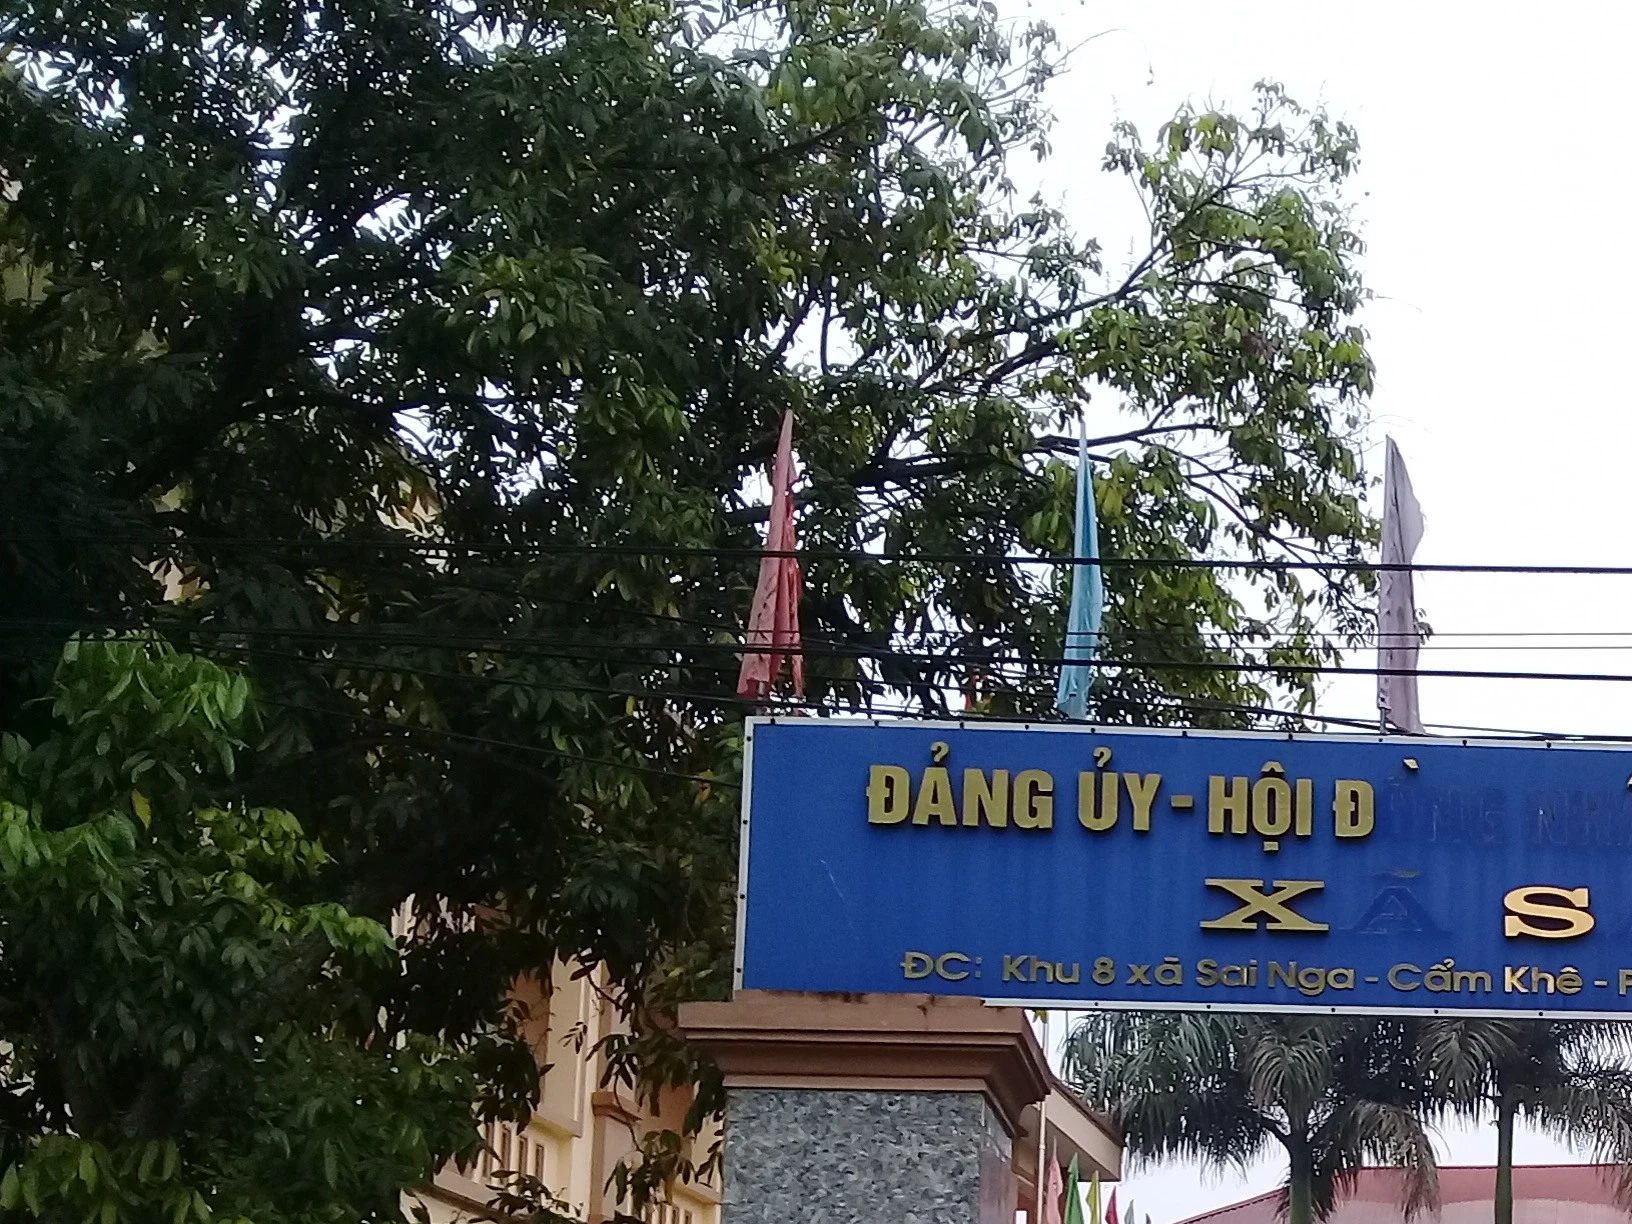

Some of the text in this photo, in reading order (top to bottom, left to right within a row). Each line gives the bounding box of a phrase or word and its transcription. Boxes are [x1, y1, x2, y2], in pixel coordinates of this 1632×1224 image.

[865, 741, 1055, 829] ĐẢNG
[900, 951, 982, 981] ĐC:
[1002, 954, 1080, 985] Khu
[1092, 957, 1115, 986] 8
[1126, 956, 1184, 986] xã
[1195, 958, 1258, 988] Sai
[1266, 960, 1356, 996] Nga
[1387, 957, 1493, 994] Cẩm
[1503, 965, 1583, 995] Khê
